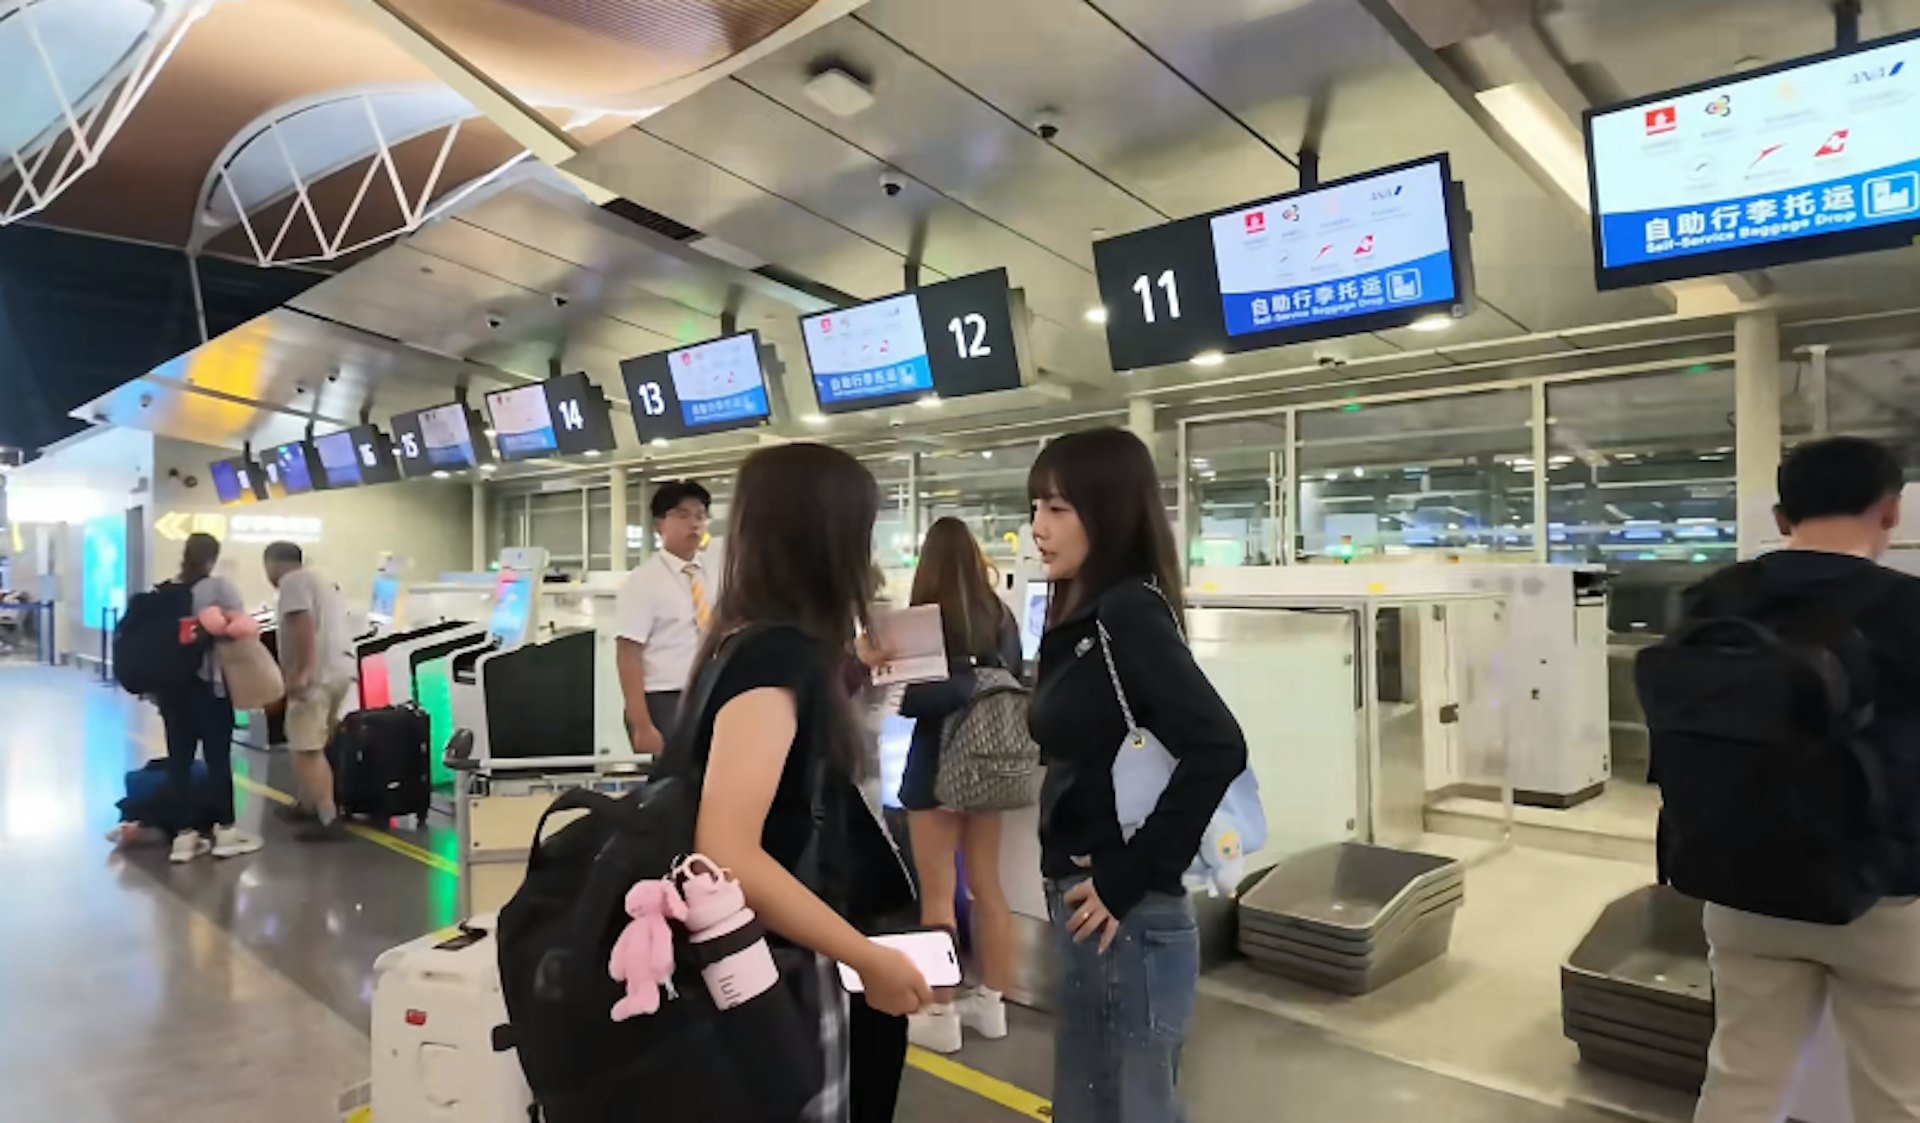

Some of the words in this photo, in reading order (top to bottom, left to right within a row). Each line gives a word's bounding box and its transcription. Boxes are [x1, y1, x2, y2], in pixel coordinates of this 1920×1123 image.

[1645, 184, 1854, 241] 自助行李托运
[1645, 231, 1735, 253] Self-Service
[1739, 218, 1809, 238] Baggage
[1815, 210, 1857, 226] Drop
[1133, 270, 1181, 323] 11
[1251, 276, 1383, 316] 自助行李托运
[948, 313, 991, 358] 12
[558, 399, 584, 431] 14
[638, 381, 665, 415] 13
[400, 432, 419, 458] 15
